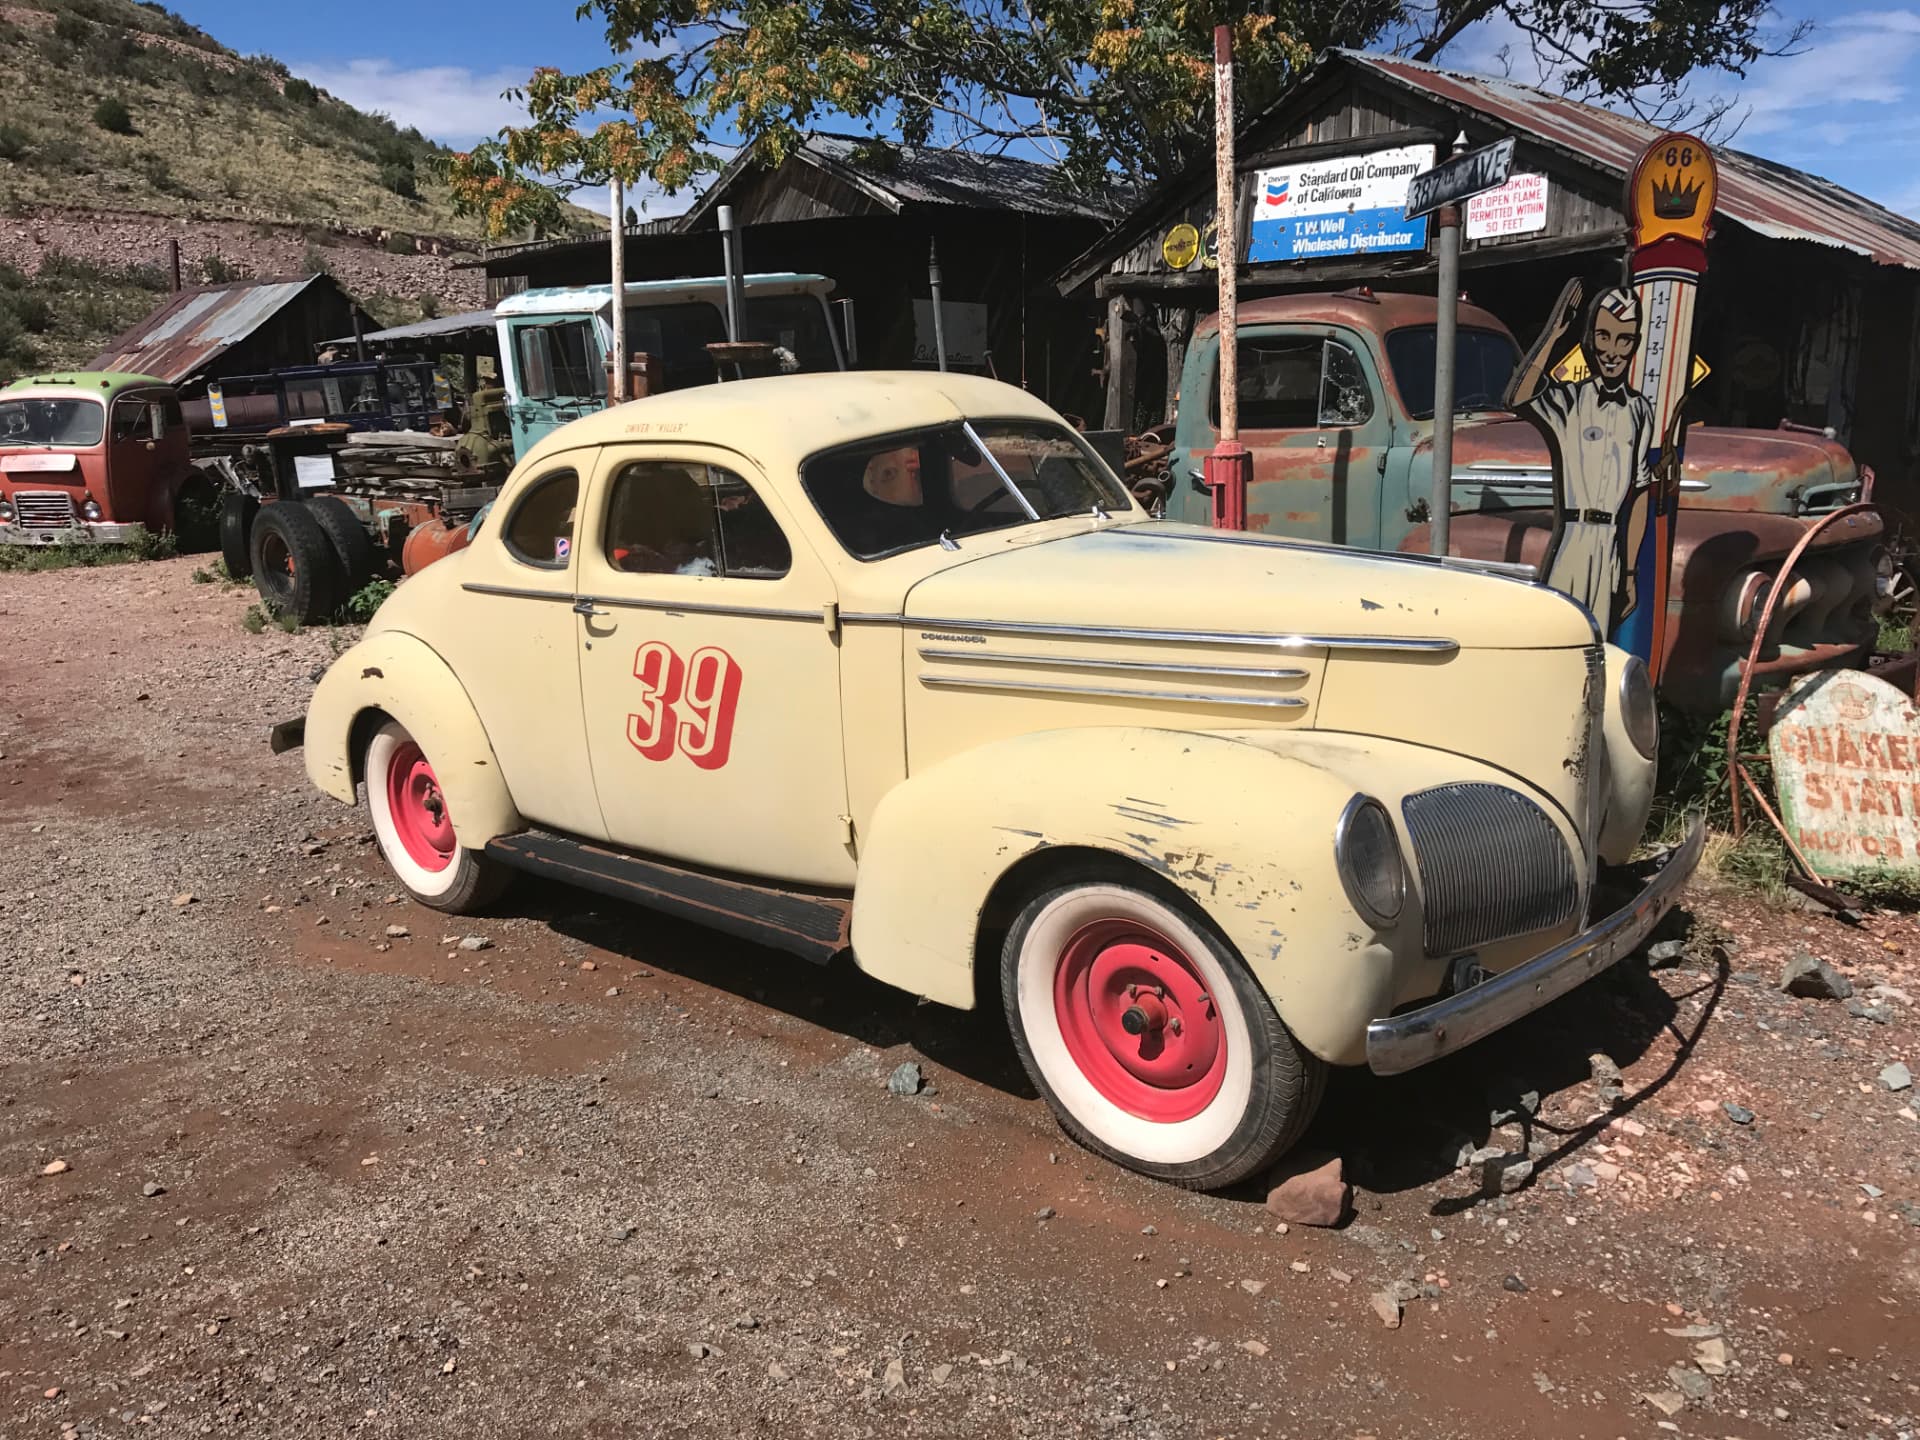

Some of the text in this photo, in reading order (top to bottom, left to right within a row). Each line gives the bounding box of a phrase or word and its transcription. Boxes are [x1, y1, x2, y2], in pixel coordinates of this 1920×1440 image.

[1665, 147, 1692, 167] 66
[1299, 162, 1421, 188] Standard Oil Company
[1467, 147, 1509, 190] AVE
[1267, 175, 1290, 184] Chevron
[1297, 186, 1362, 204] of California
[1471, 189, 1541, 210] OR OPEN FLAME
[1470, 202, 1544, 223] PERMITTED WITHIN
[1486, 218, 1524, 233] 50 FEET
[1293, 231, 1413, 253] Wholesale Distributor
[1655, 315, 1662, 329] 2
[1651, 341, 1659, 355] 3
[626, 640, 743, 771] 39
